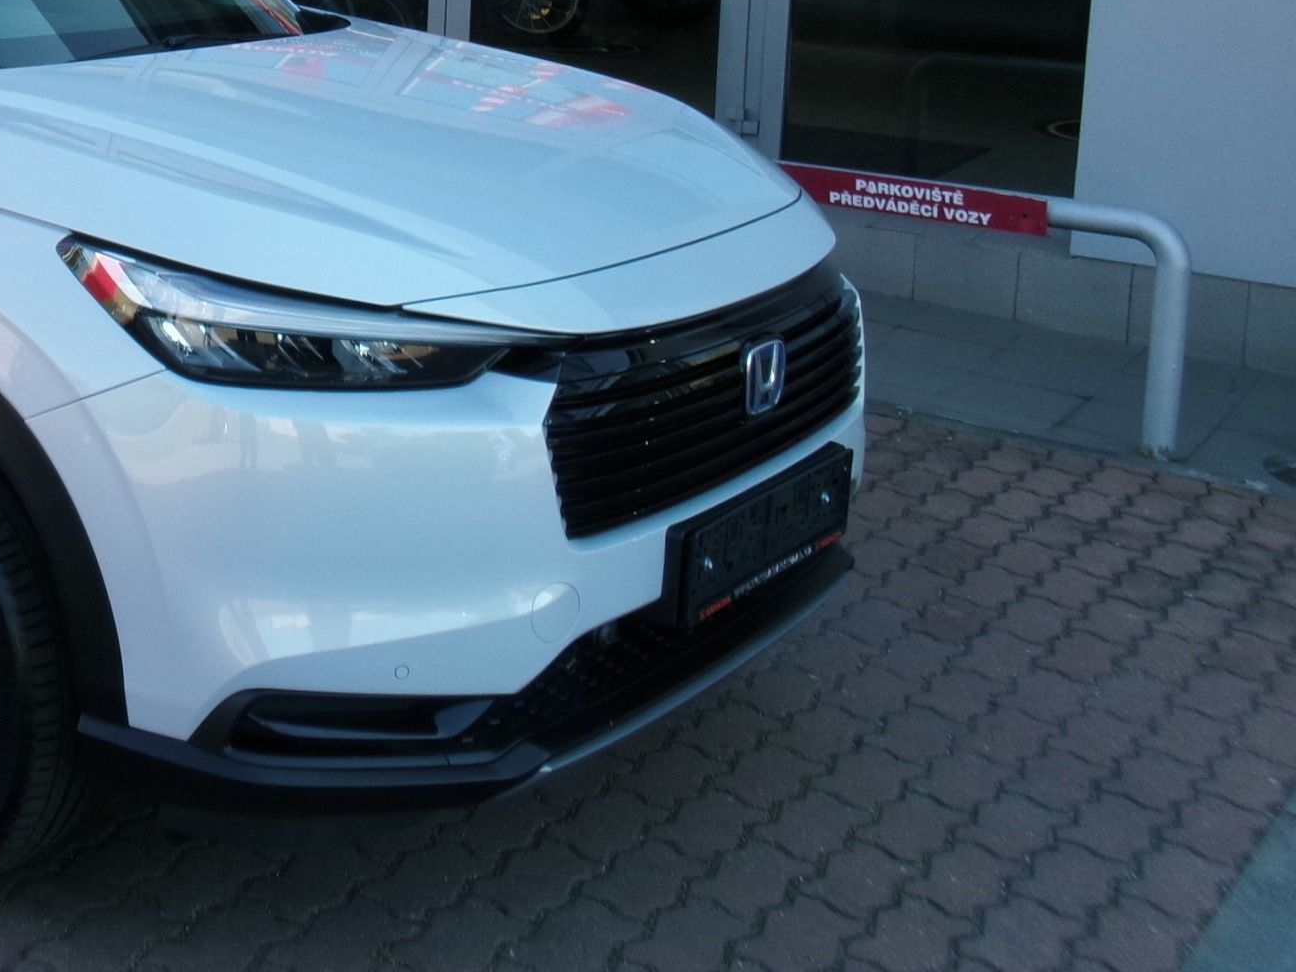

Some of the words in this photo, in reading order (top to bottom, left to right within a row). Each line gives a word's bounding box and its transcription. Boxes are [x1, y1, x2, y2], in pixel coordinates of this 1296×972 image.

[855, 179, 964, 206] PARKOVIŠTĚ
[830, 191, 939, 218] PŘEDVÁDĚCÍ
[944, 207, 992, 226] VOZY
